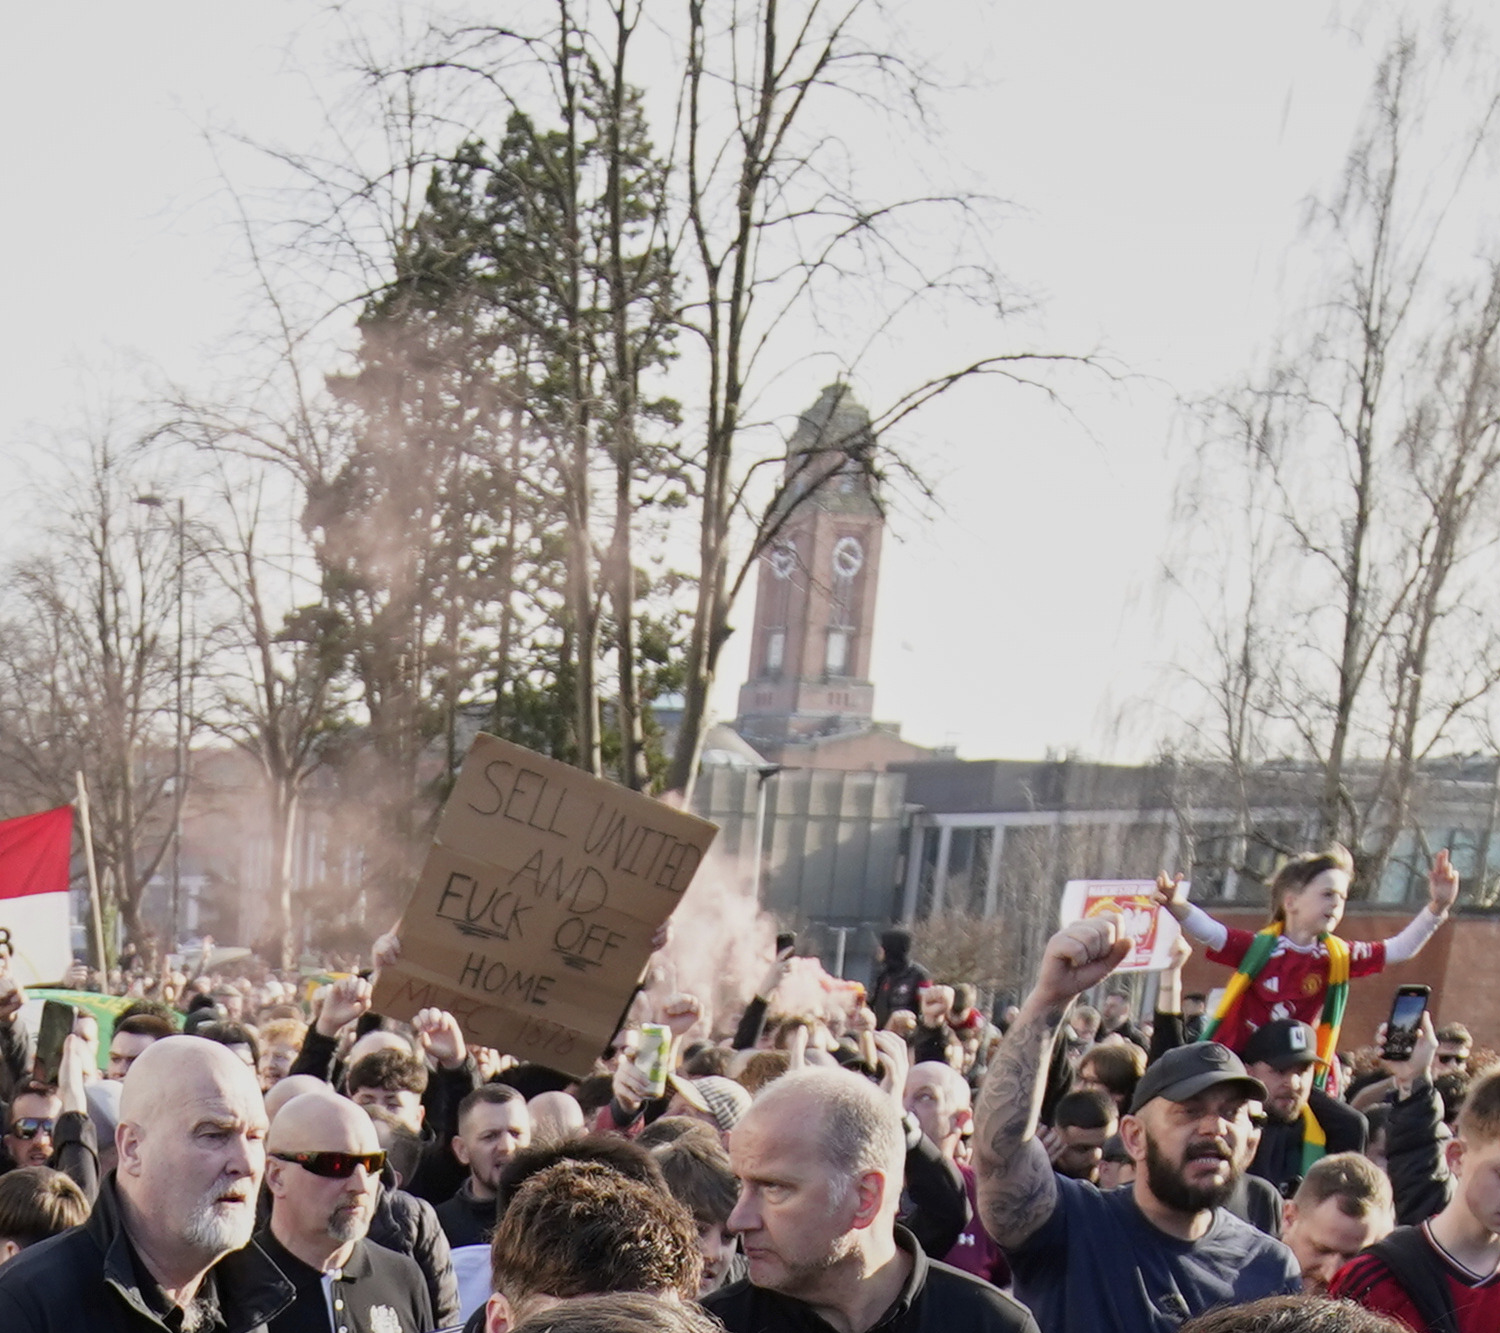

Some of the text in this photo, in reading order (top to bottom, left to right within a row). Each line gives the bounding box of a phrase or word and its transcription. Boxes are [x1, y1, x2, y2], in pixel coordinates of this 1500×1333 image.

[468, 760, 701, 892] SELL UNITED
[436, 872, 626, 963] FUCK OFF
[507, 850, 608, 914] AND
[459, 952, 556, 1004] HOME
